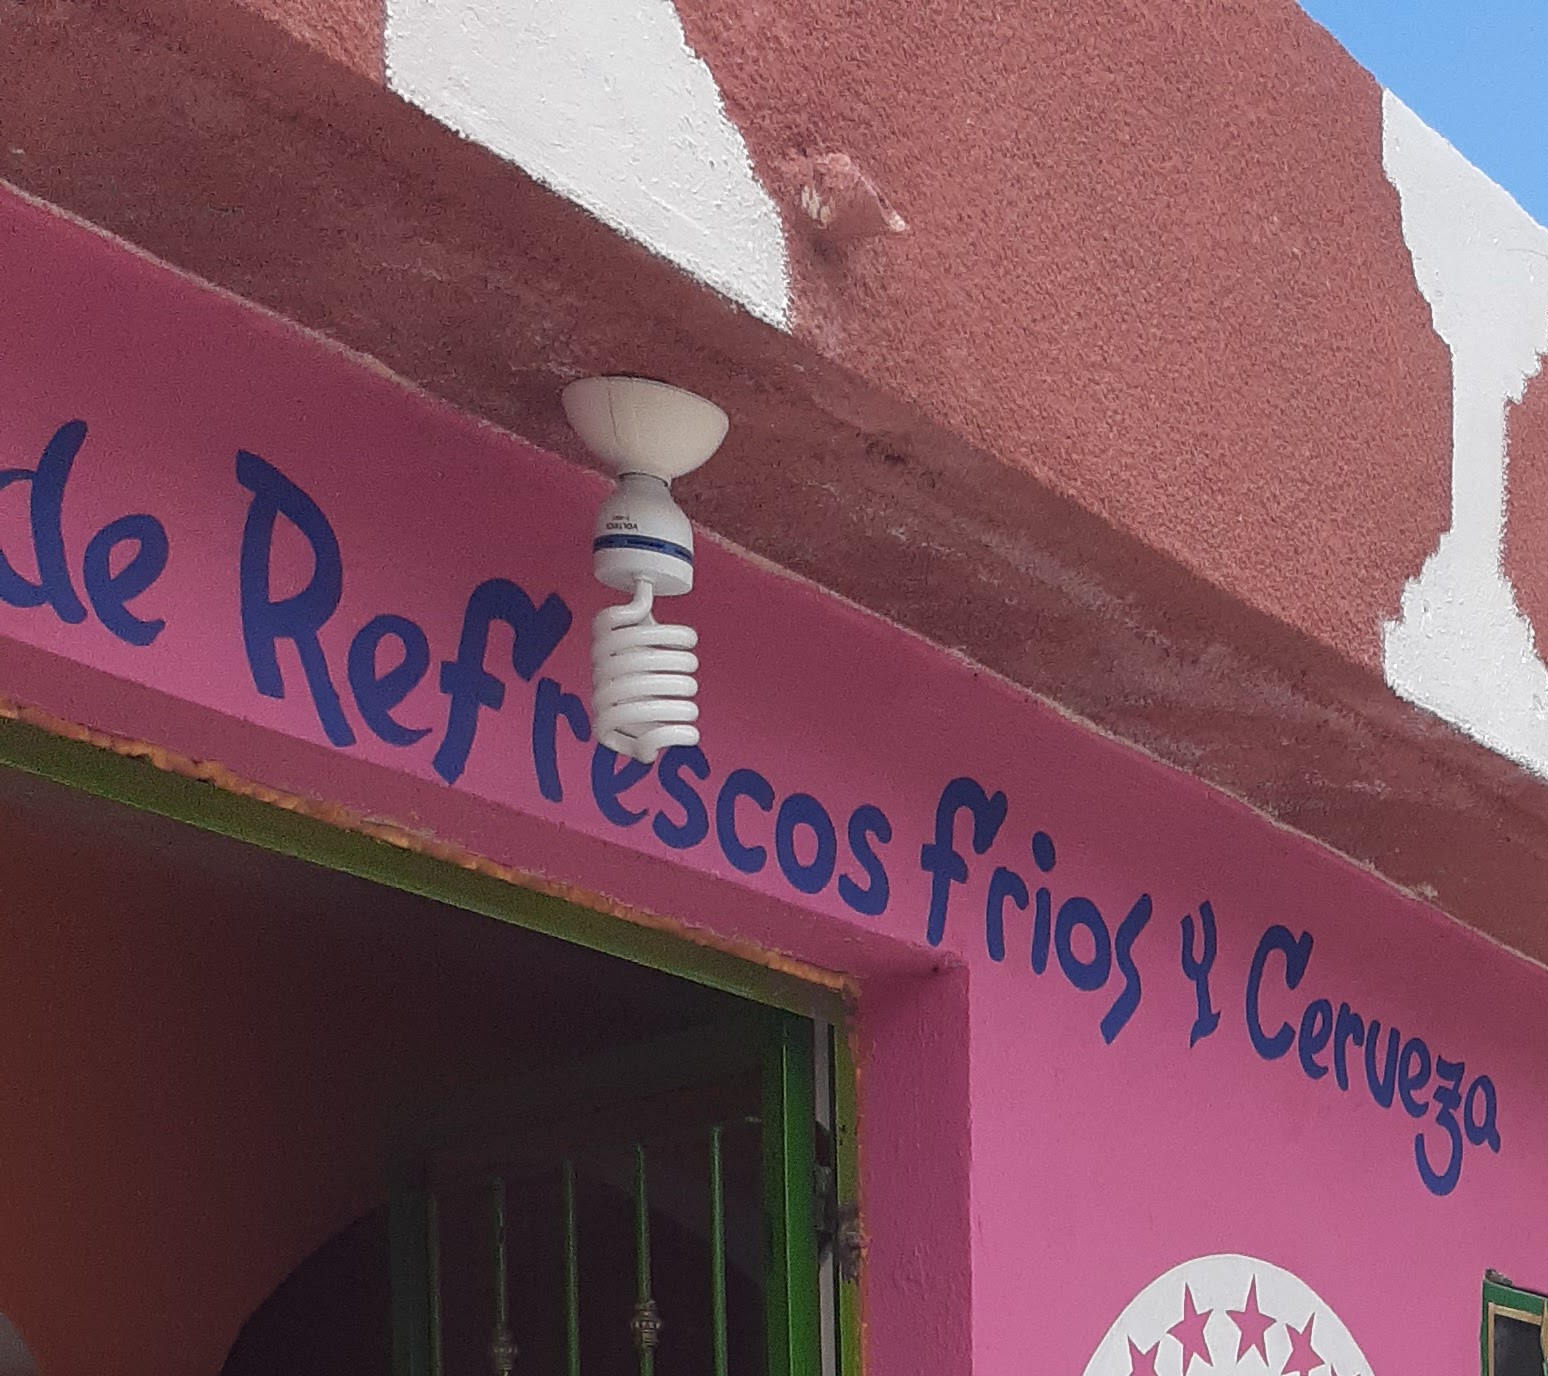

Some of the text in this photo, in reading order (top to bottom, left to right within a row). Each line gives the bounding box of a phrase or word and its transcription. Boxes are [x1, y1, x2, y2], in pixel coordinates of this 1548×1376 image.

[0, 420, 169, 647] de
[235, 449, 893, 917] Refrescos
[921, 777, 1152, 1045] frios
[1246, 924, 1502, 1196] Cerveza
